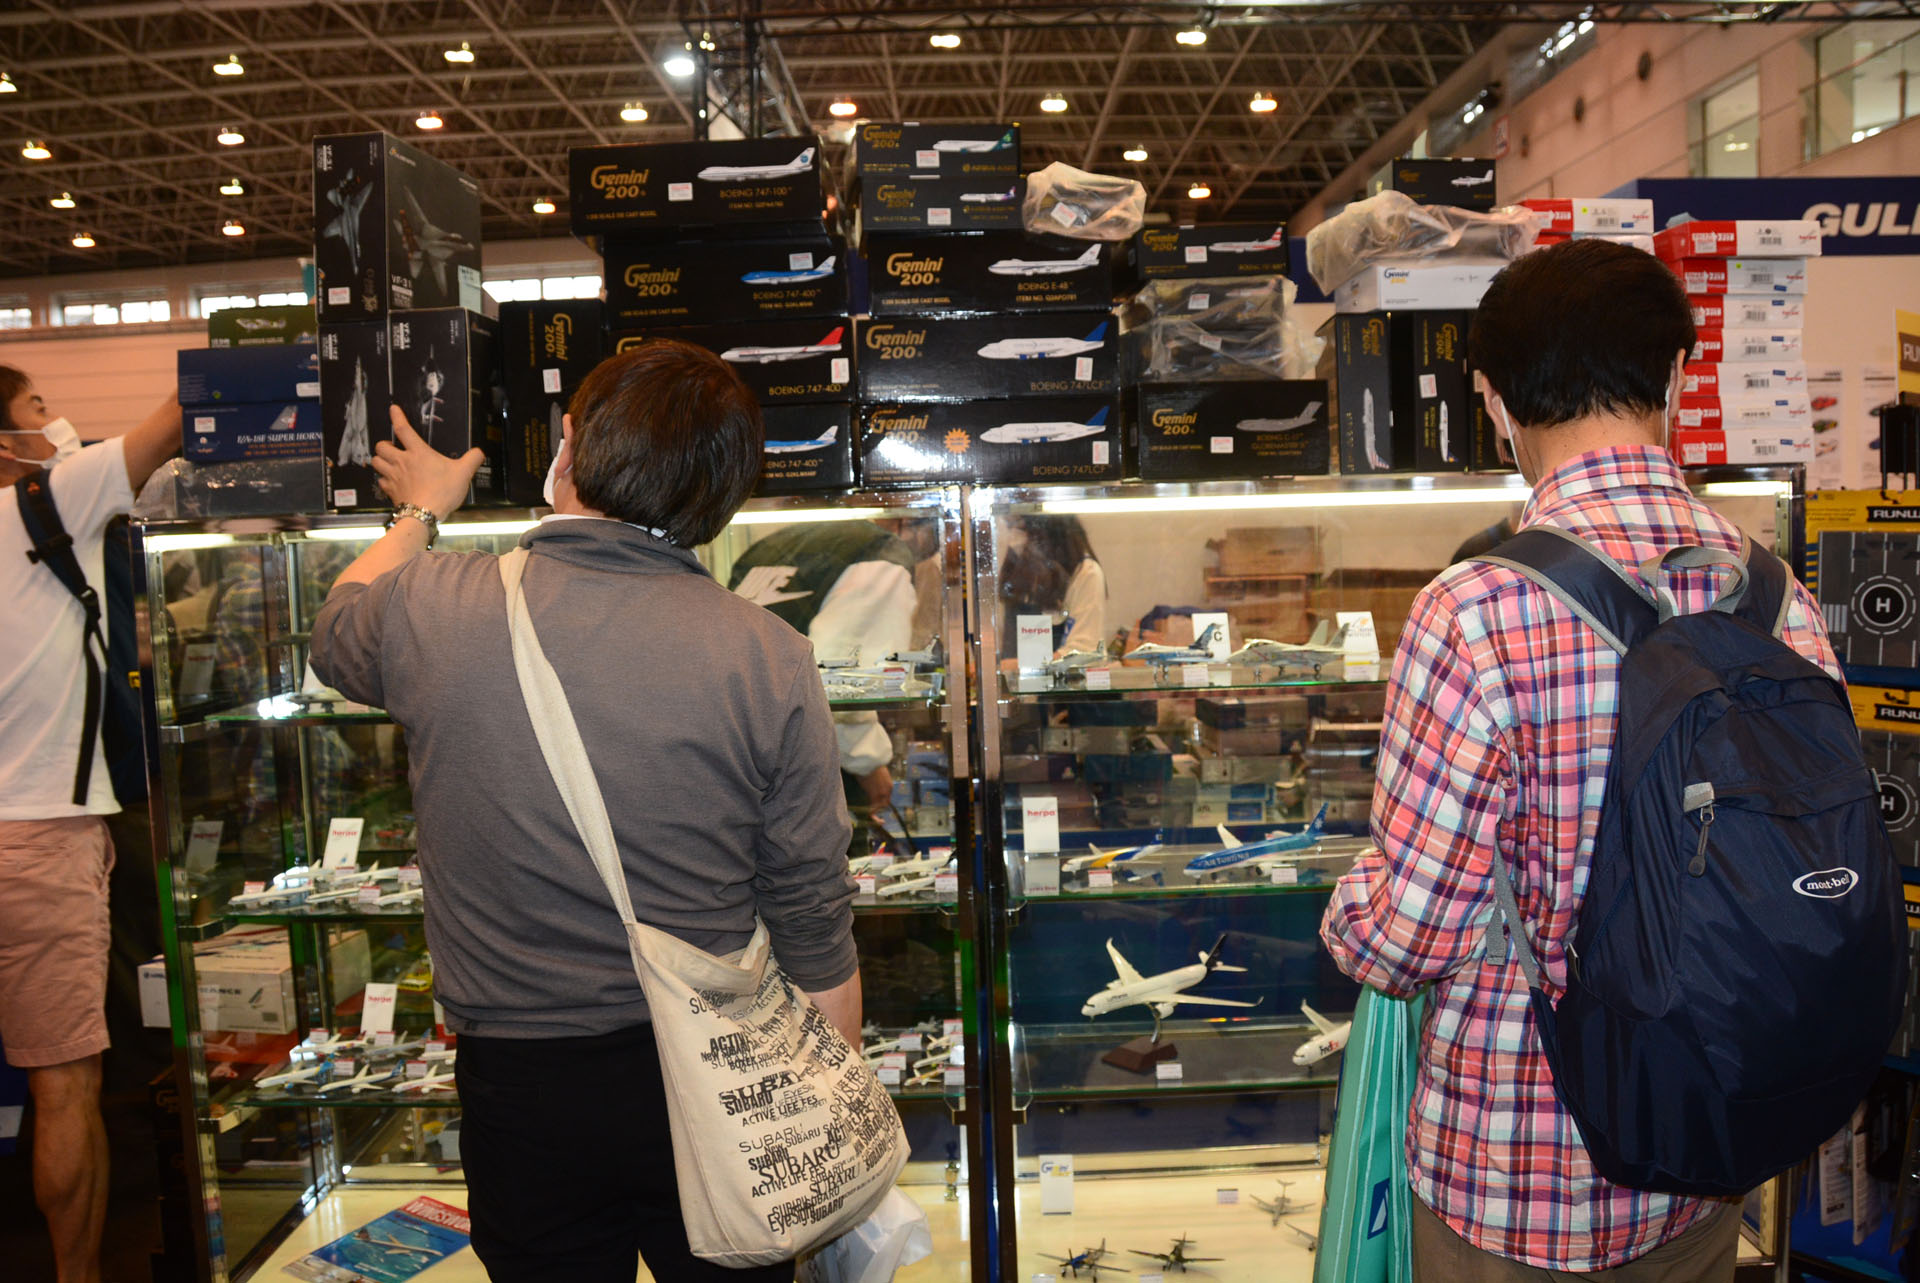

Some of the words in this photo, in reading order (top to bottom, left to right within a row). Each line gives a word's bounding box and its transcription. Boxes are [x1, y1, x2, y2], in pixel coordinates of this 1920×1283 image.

[591, 164, 649, 190] Gemini
[604, 185, 640, 199] 200
[720, 188, 752, 198] BOEING
[1801, 203, 1920, 237] GUL
[886, 252, 944, 277] Gemini
[624, 264, 681, 288] Gemini
[900, 272, 935, 286] 200
[637, 283, 672, 297] 200
[1017, 281, 1050, 291] BOEING
[753, 290, 784, 300] BOEING
[544, 324, 554, 354] 200
[553, 313, 573, 360] Gemini
[866, 324, 927, 349] Gemini
[880, 346, 916, 359] 200
[769, 385, 804, 396] BOEING
[807, 384, 842, 394] 747-400
[1030, 381, 1068, 391] BOEING
[1070, 380, 1105, 390] 747LCF
[870, 409, 929, 434] Gemini
[1152, 408, 1197, 427] Gemini
[1163, 424, 1190, 435] 200
[267, 432, 295, 442] SUPER
[788, 458, 818, 468] 747-400
[1032, 466, 1070, 476] BOEING
[1073, 464, 1106, 474] 747LCF
[1021, 626, 1050, 635] herpa
[1027, 809, 1056, 818] herpa
[725, 1090, 773, 1116] SUBARU
[786, 1126, 821, 1149] SUBARU
[759, 1143, 841, 1185] SUBARU
[751, 1180, 788, 1198] ACTIVE
[788, 1169, 809, 1186] LIFE
